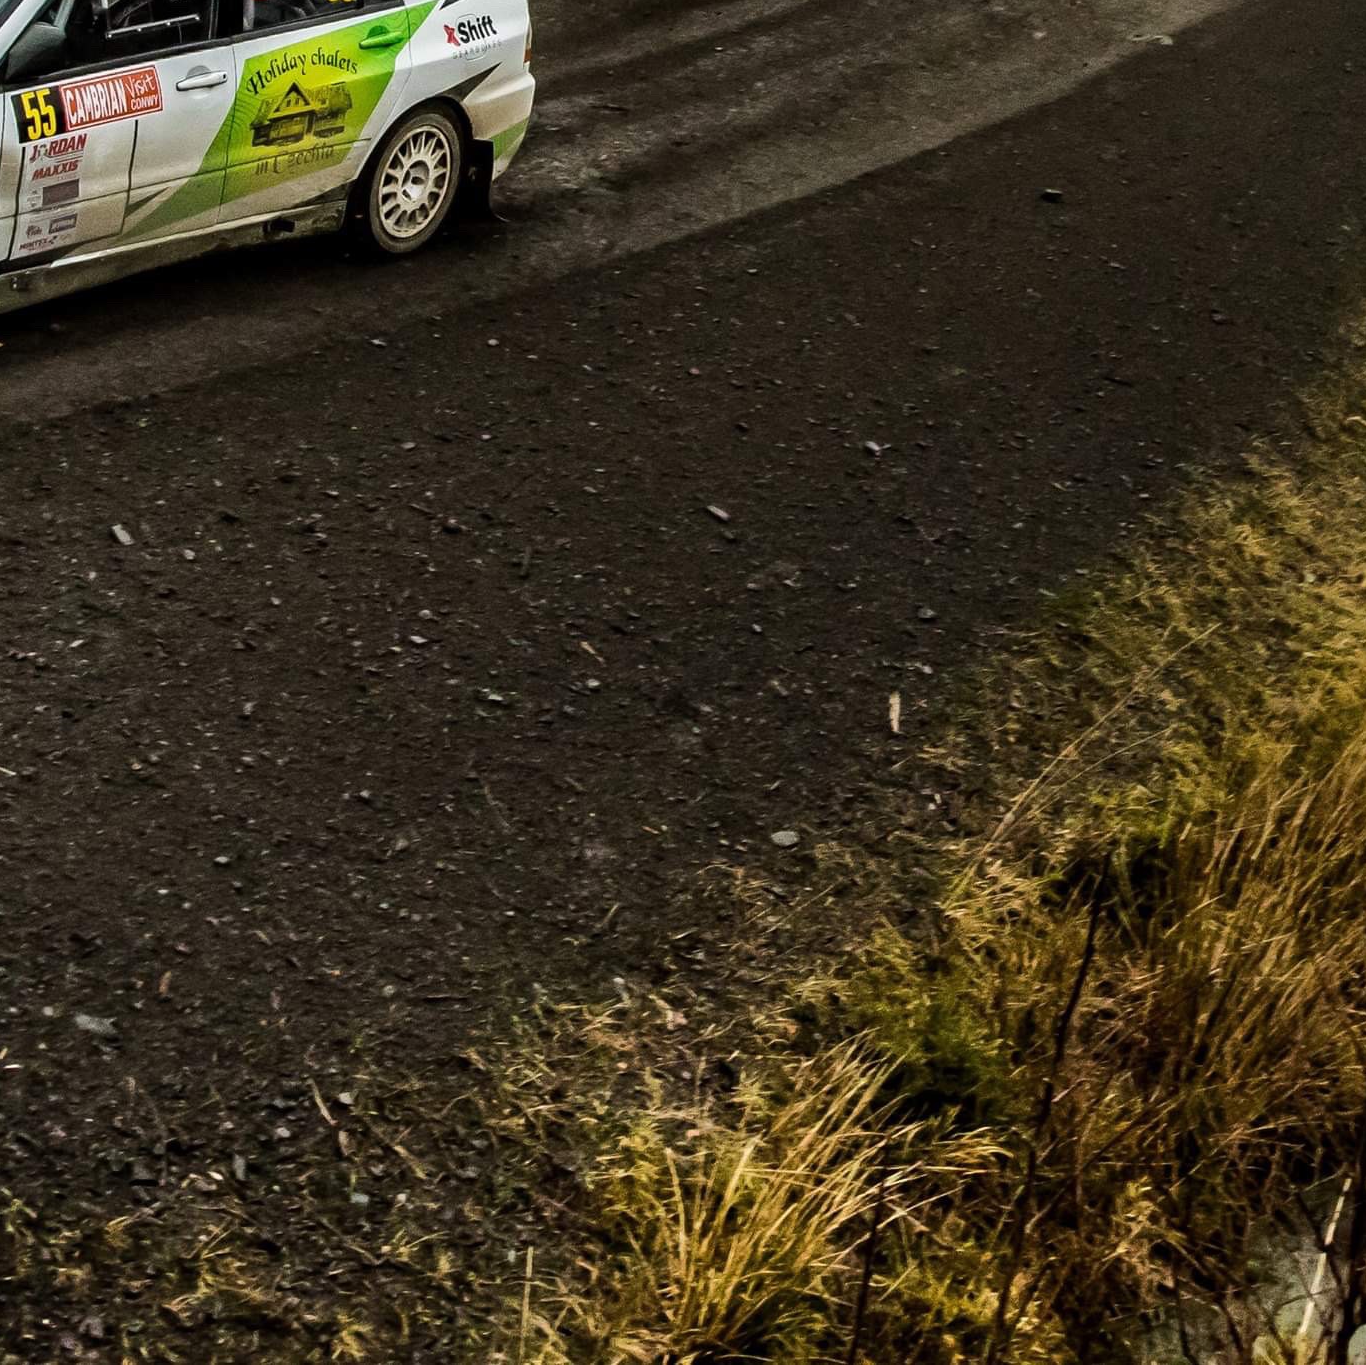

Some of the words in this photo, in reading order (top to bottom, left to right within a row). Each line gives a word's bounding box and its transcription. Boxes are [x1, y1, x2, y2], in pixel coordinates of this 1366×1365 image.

[125, 72, 156, 99] Visit
[246, 52, 307, 95] Holiday
[310, 47, 358, 75] chalets
[20, 88, 58, 141] 55
[65, 78, 129, 125] CAMBRIAN
[130, 95, 159, 111] CONWY
[31, 160, 82, 181] MAXXIS
